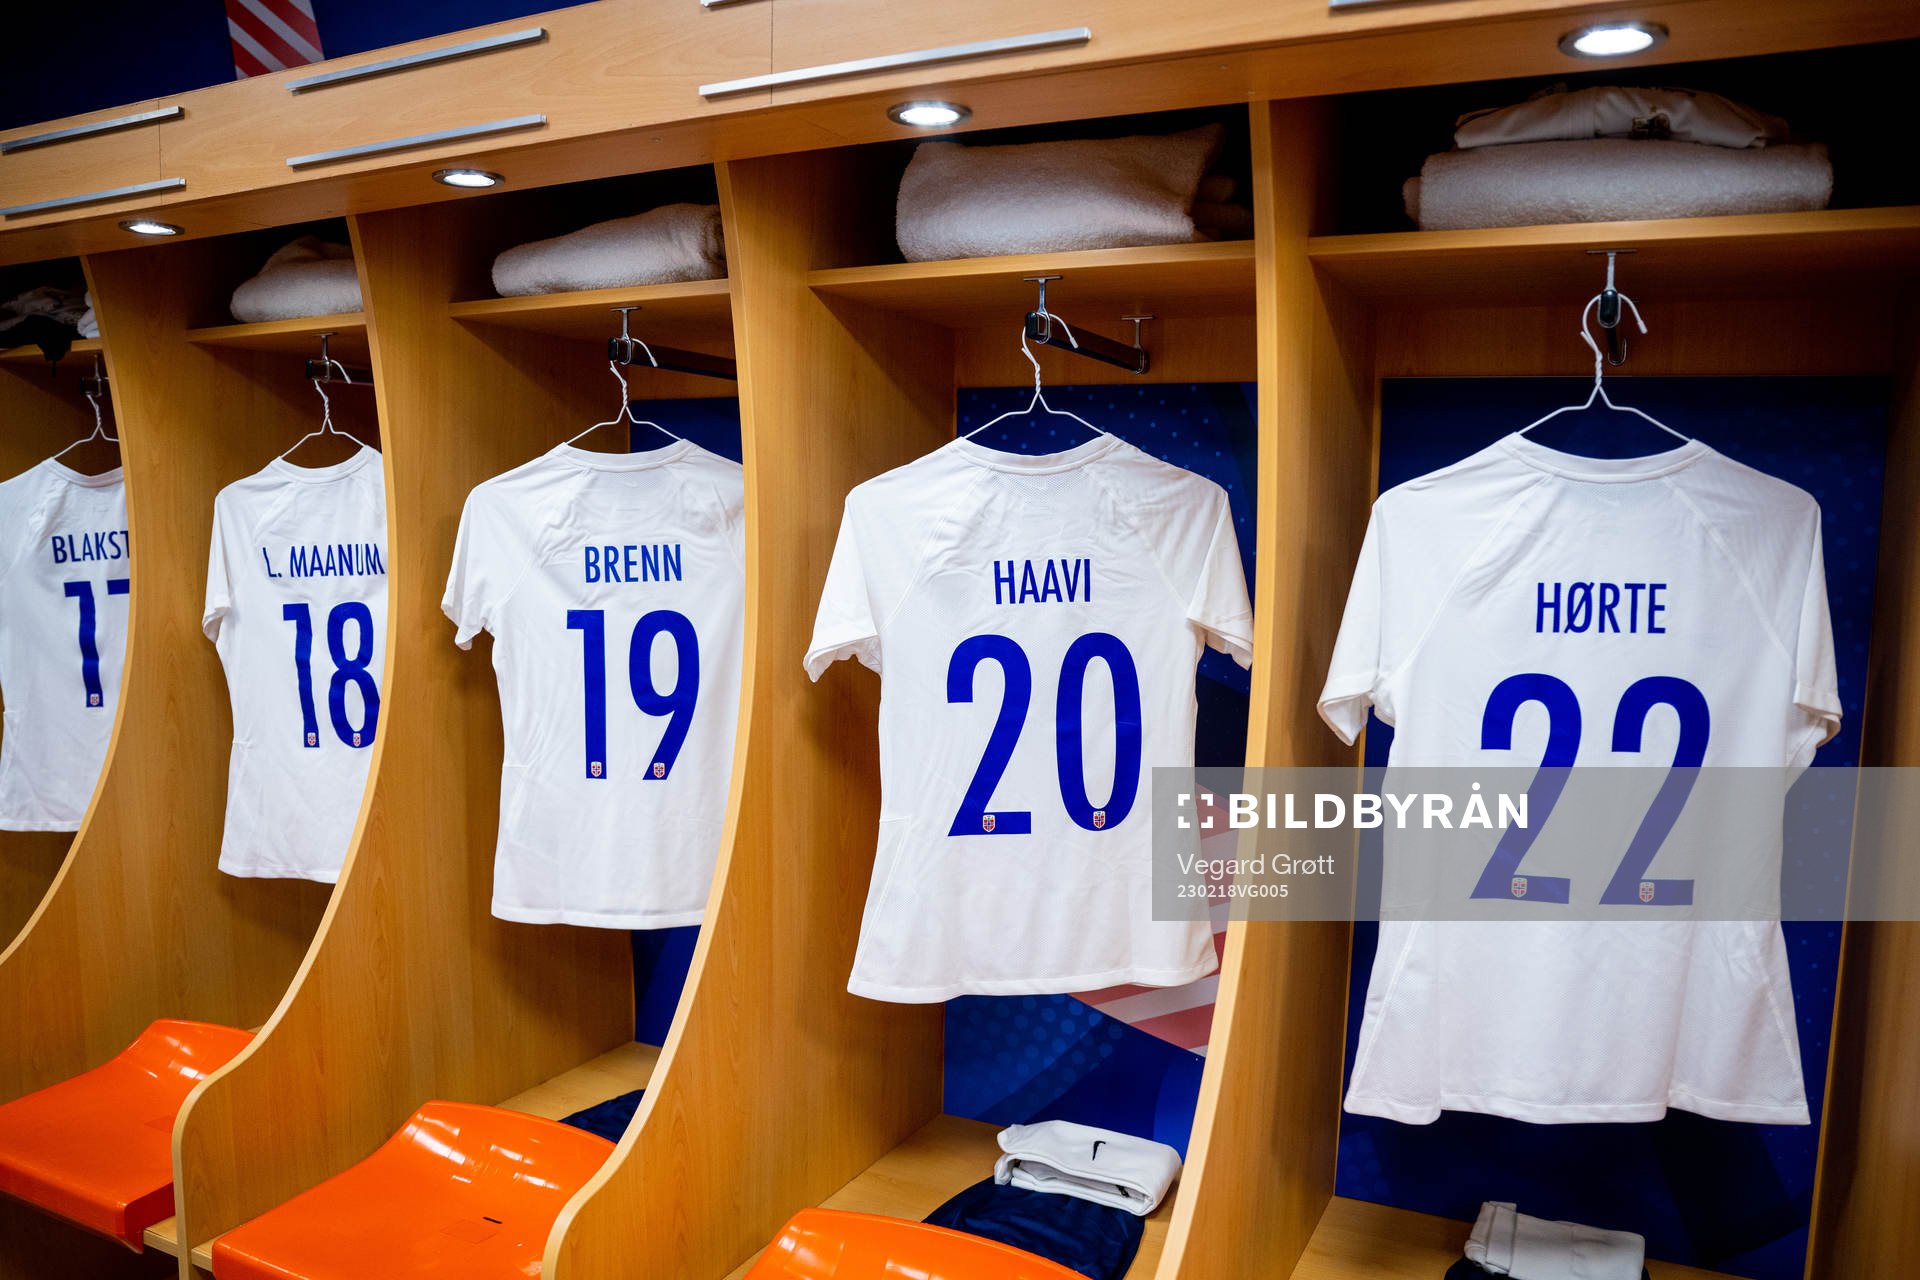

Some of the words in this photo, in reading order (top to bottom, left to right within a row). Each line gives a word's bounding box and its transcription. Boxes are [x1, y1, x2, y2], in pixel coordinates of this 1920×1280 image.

[262, 547, 283, 578] L.
[289, 543, 385, 578] MAANUM
[584, 543, 683, 584] BRENN
[993, 558, 1091, 605] HAAVI
[1535, 581, 1668, 635] HØRTE
[282, 601, 381, 749] 18
[566, 609, 701, 781] 19
[946, 631, 1143, 837] 20
[1469, 672, 1711, 905] 22
